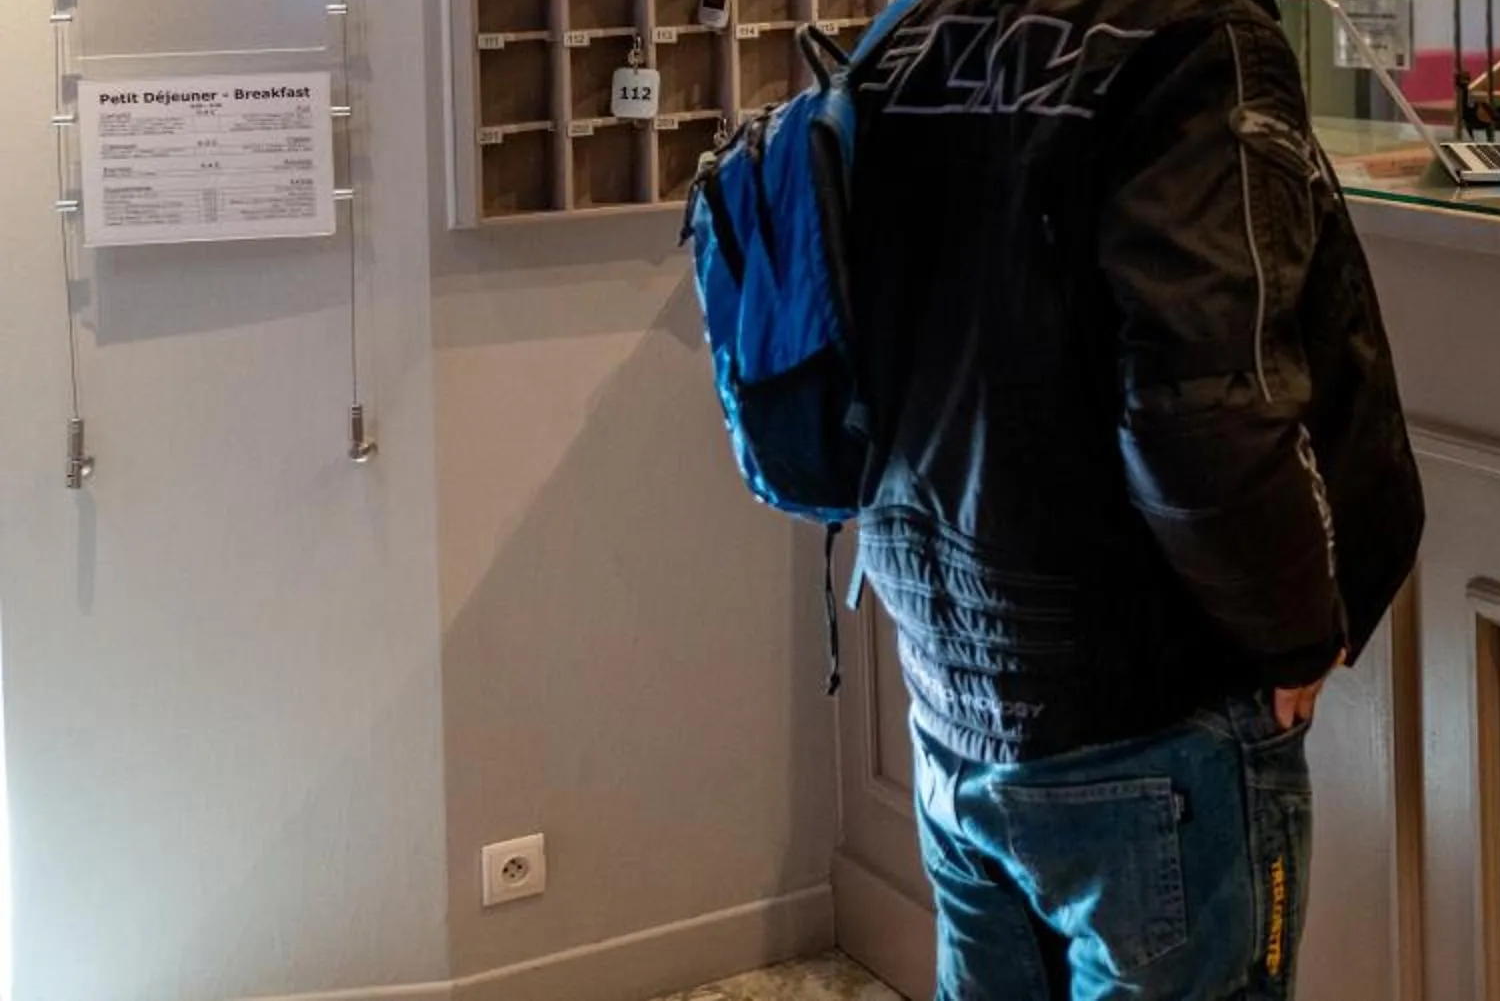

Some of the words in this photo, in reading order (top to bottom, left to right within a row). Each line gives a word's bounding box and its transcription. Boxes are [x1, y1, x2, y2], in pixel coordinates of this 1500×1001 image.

[100, 92, 138, 105] Petit
[143, 90, 217, 106] Déjeuner
[235, 86, 311, 100] Breakfast
[620, 86, 651, 100] 112
